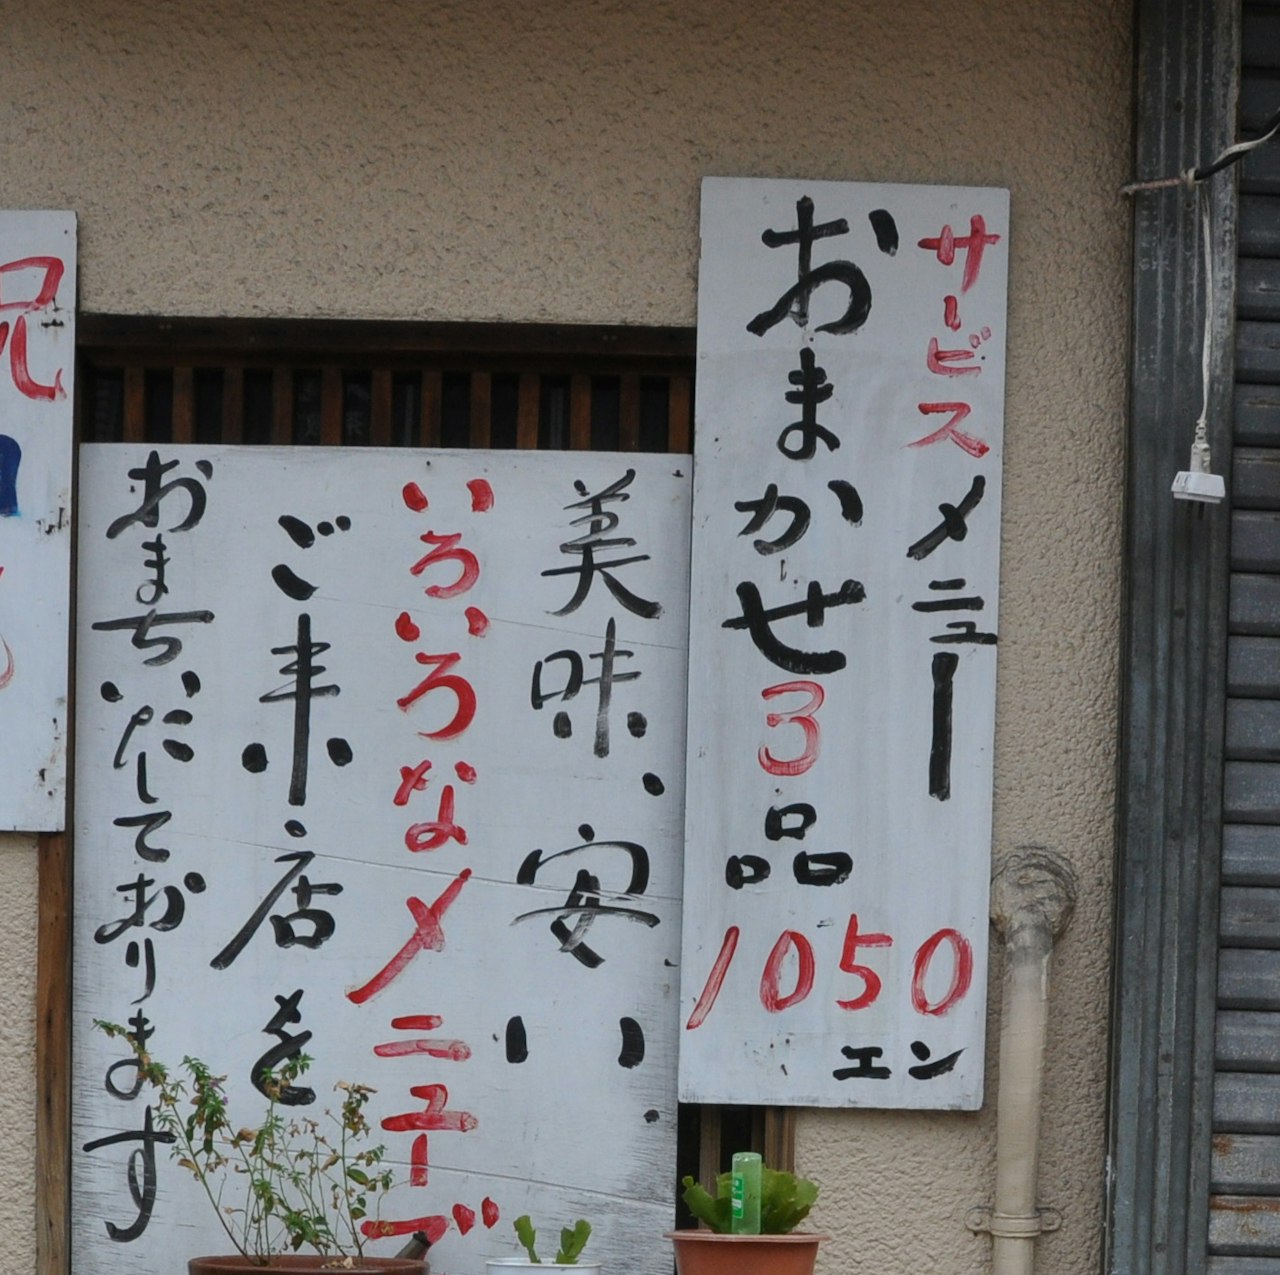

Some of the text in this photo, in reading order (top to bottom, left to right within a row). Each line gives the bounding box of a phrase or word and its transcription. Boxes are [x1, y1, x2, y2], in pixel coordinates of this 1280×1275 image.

[721, 194, 900, 890] おまかせ3品
[905, 213, 1001, 802] サービスメニュー
[83, 450, 216, 1243] おまちいたしております
[209, 514, 355, 1107] ご来店を
[686, 913, 974, 1031] 1050
[832, 1039, 968, 1081] エン
